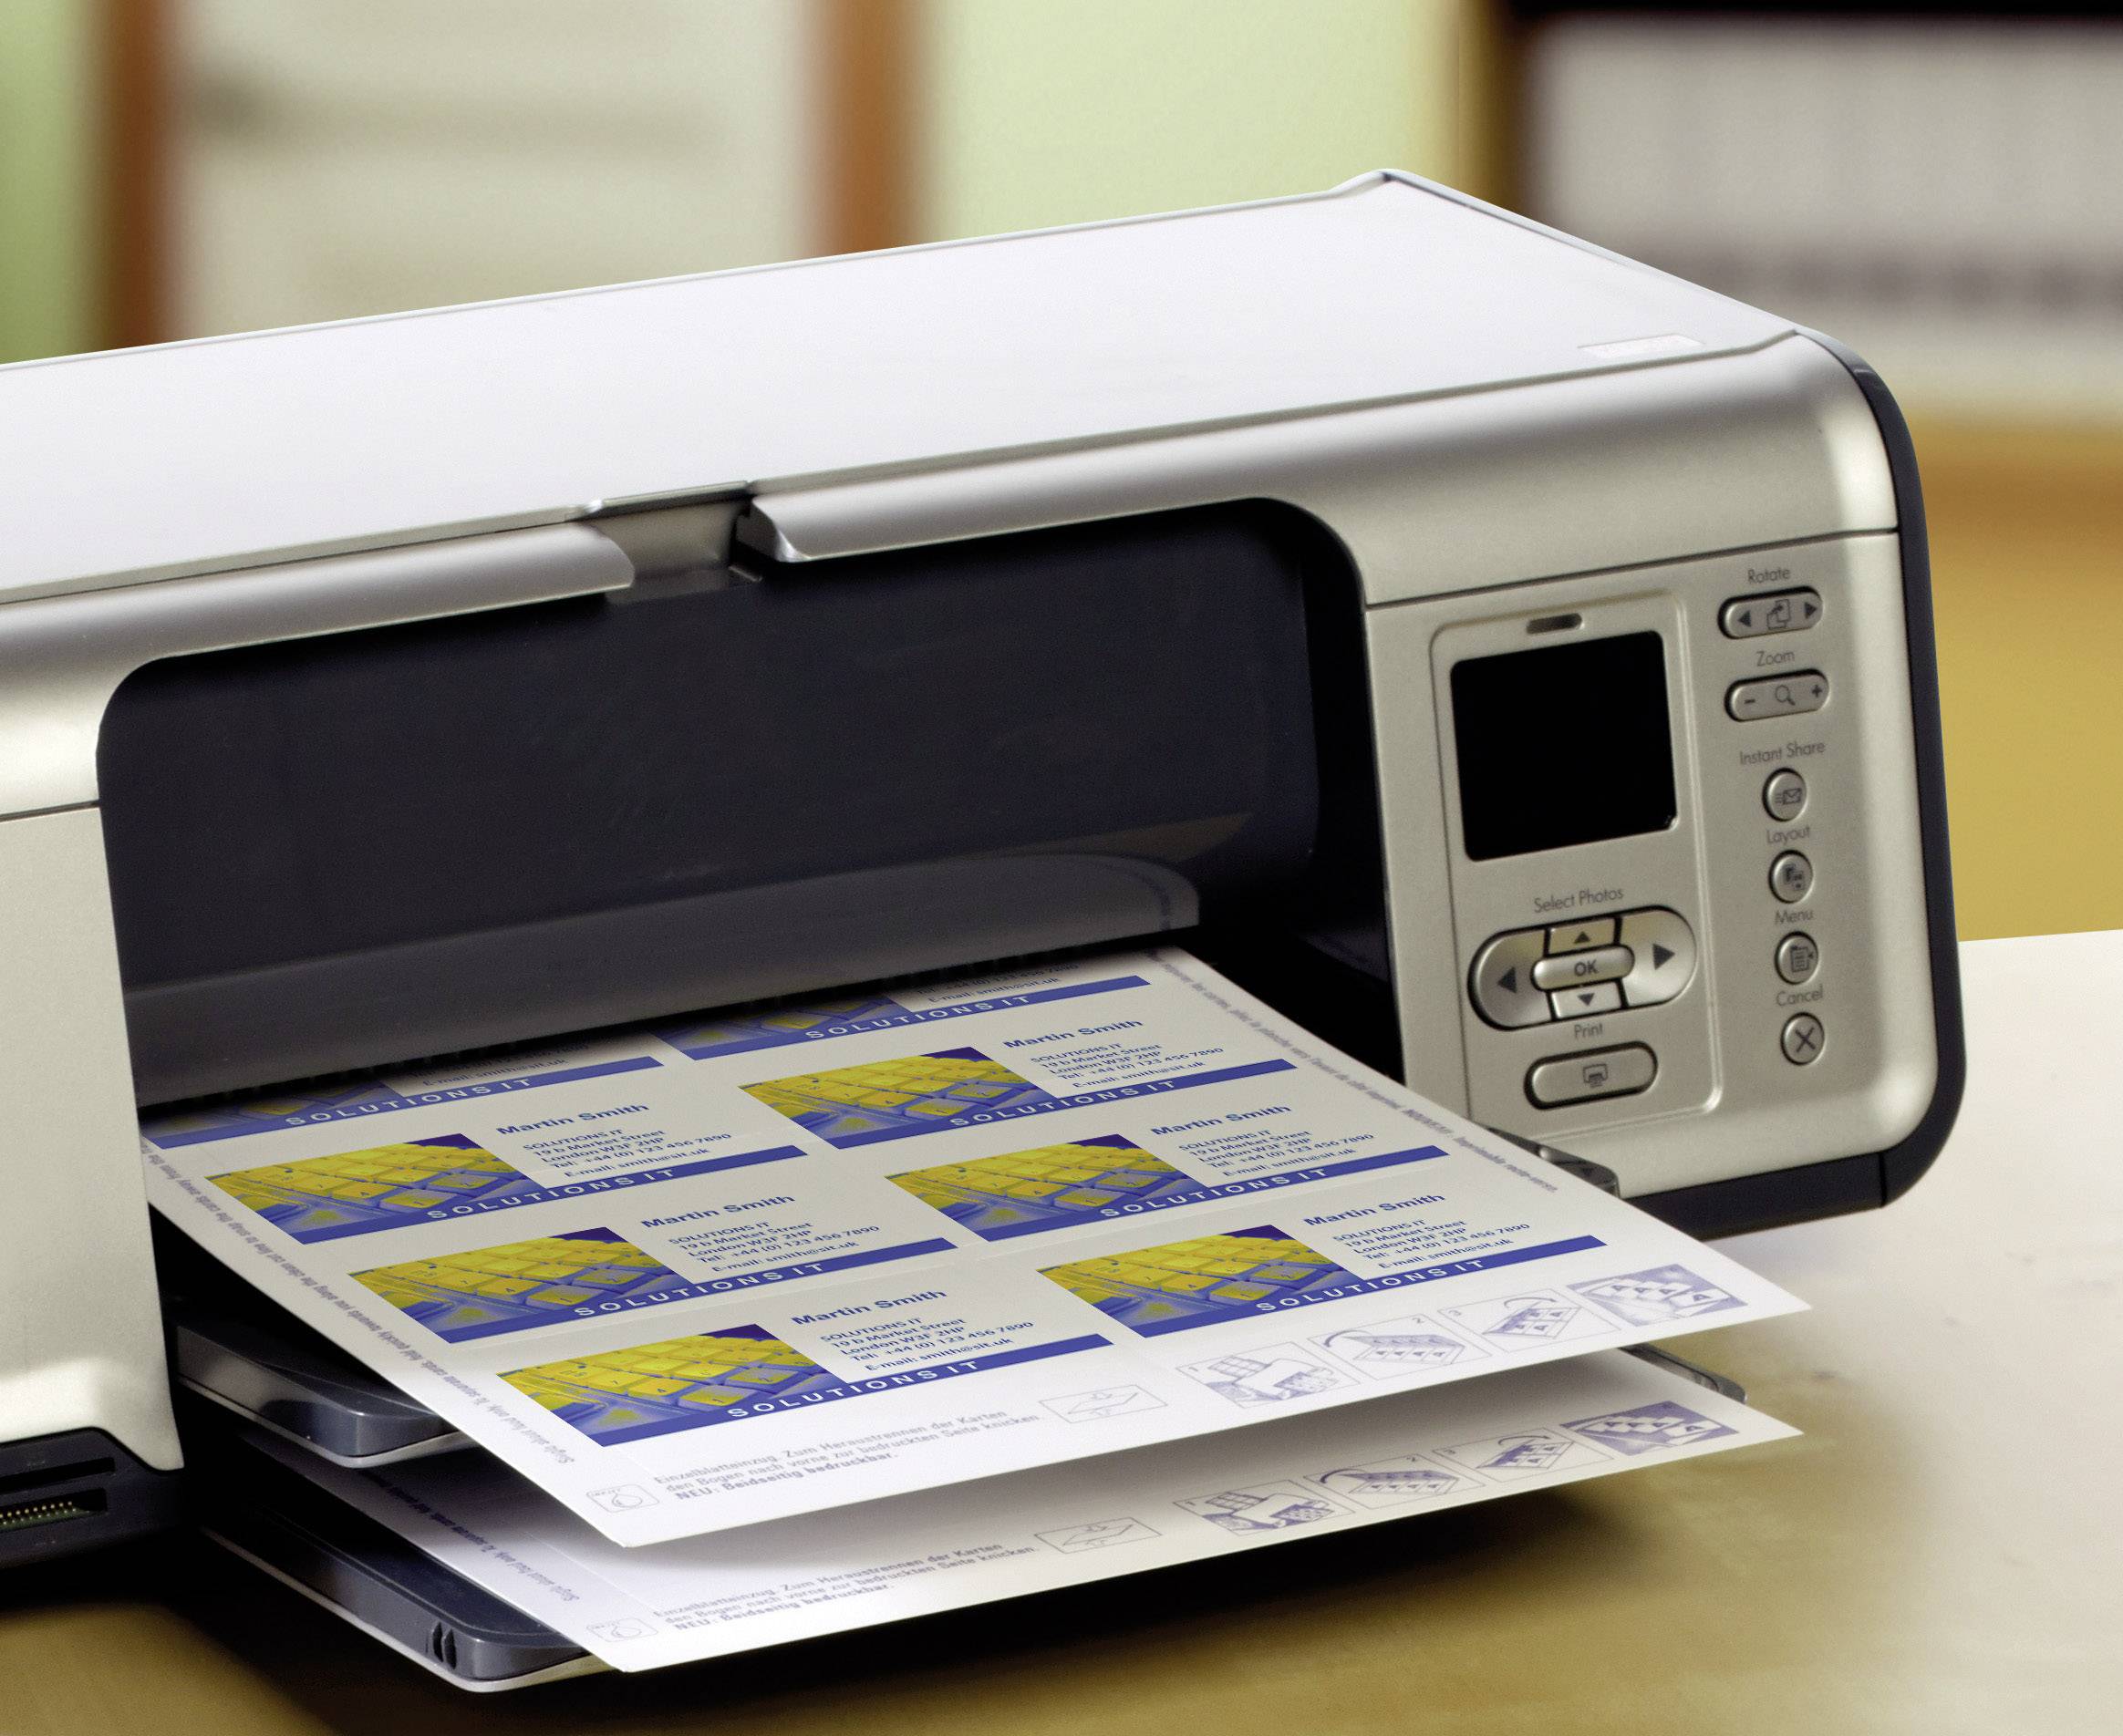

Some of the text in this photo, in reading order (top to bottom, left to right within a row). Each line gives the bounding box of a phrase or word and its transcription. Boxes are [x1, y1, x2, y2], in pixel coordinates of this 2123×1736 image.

[1748, 566, 1791, 583] Rotate
[1756, 649, 1795, 666] Zoom
[1740, 739, 1825, 765] Instant Share
[1766, 824, 1811, 847] Layout
[1535, 886, 1624, 913] Select Photos
[1775, 908, 1814, 924] Menu
[1574, 958, 1598, 976] OK
[1776, 986, 1824, 1005] Cancel
[806, 997, 1029, 1038] SOLUTIONS IT
[1003, 1021, 1143, 1048] Martin Smith
[1574, 1021, 1604, 1039] Print
[286, 1079, 531, 1124] SOLUTIONS IT
[951, 1080, 1175, 1125] SOLUTIONS IT
[497, 1105, 648, 1134] Martin Smith
[1151, 1107, 1290, 1135] Martin Smith
[523, 1132, 607, 1150] SOLUTIONS
[1179, 1133, 1257, 1151] SOLUTIONS
[1198, 1138, 1310, 1162] London W3F 2HP
[1220, 1139, 1269, 1151] Market
[1269, 1132, 1310, 1141] Street
[1239, 1154, 1265, 1162] +44
[1341, 1134, 1373, 1143] 7890
[542, 1151, 599, 1162] London
[1223, 1165, 1270, 1176] E-mail:
[428, 1169, 675, 1218] SOLUTIONS IT
[1101, 1169, 1327, 1216] SOLUTIONS IT
[641, 1197, 794, 1227] Martin Smith
[1304, 1195, 1445, 1225] Martin Smith
[669, 1225, 754, 1244] SOLUTIONS
[713, 1232, 765, 1244] Market
[767, 1223, 813, 1234] Street
[731, 1248, 760, 1256] +44
[843, 1226, 879, 1236] 7890
[1333, 1224, 1412, 1241] SOLUTIONS
[1353, 1228, 1465, 1254] London W3F 2HP
[1375, 1229, 1423, 1241] Market
[1424, 1221, 1466, 1231] Street
[1396, 1245, 1420, 1254] +44
[1496, 1224, 1529, 1234] 7890
[689, 1231, 811, 1256] London W3F 2HP
[712, 1259, 761, 1272] E-mail:
[1379, 1256, 1425, 1268] E-mail:
[575, 1264, 823, 1316] SOLUTIONS IT
[1257, 1260, 1484, 1310] SOLUTIONS IT
[792, 1292, 946, 1324] Martin Smith
[821, 1322, 906, 1341] SOLUTIONS
[841, 1327, 964, 1355] London W3F 2HP
[852, 1353, 878, 1361] Tel:
[885, 1346, 912, 1354] +44
[915, 1341, 936, 1349] (0)
[937, 1336, 965, 1344] 123
[997, 1322, 1033, 1332] 7890
[865, 1328, 918, 1341] Market
[920, 1319, 965, 1330] Street
[865, 1358, 917, 1370] E-mail:
[729, 1361, 979, 1417] SOLUTIONS IT
[930, 1421, 954, 1430] der
